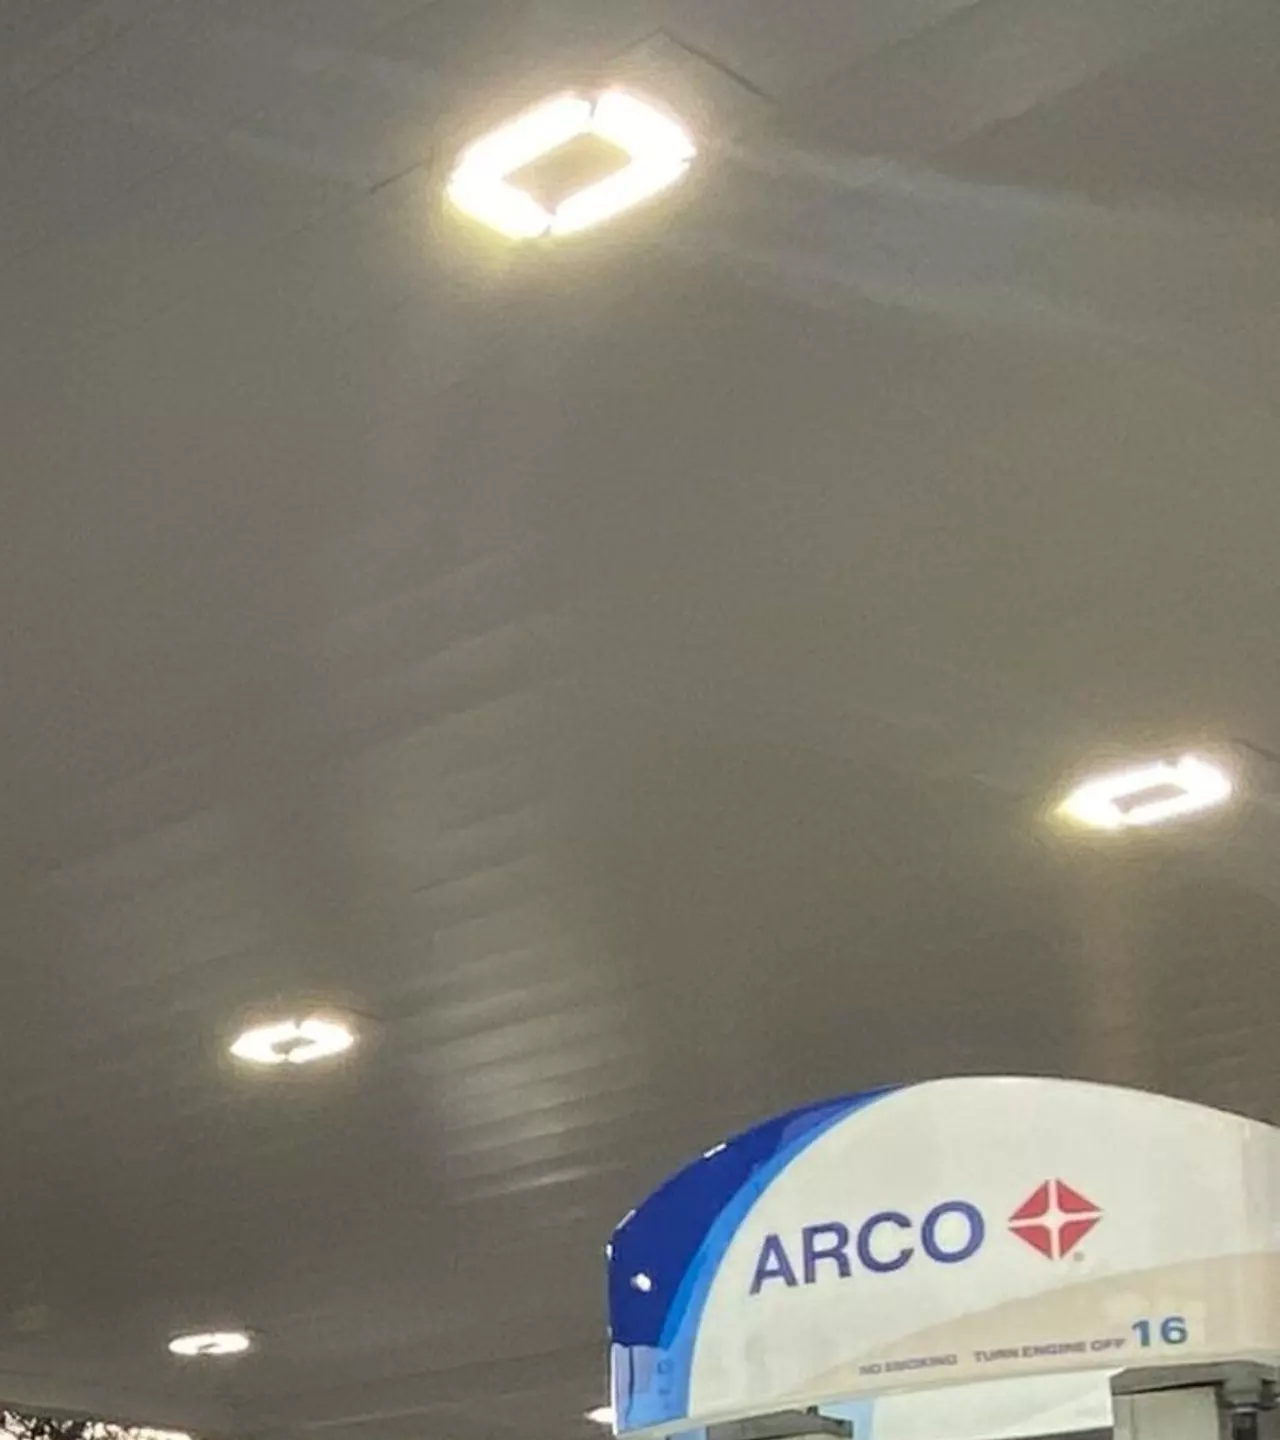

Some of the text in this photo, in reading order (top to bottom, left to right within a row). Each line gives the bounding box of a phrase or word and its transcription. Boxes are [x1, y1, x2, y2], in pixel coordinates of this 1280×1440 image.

[748, 1200, 986, 1296] ARCO
[1131, 1316, 1188, 1347] 16
[974, 1345, 1019, 1363] TURN
